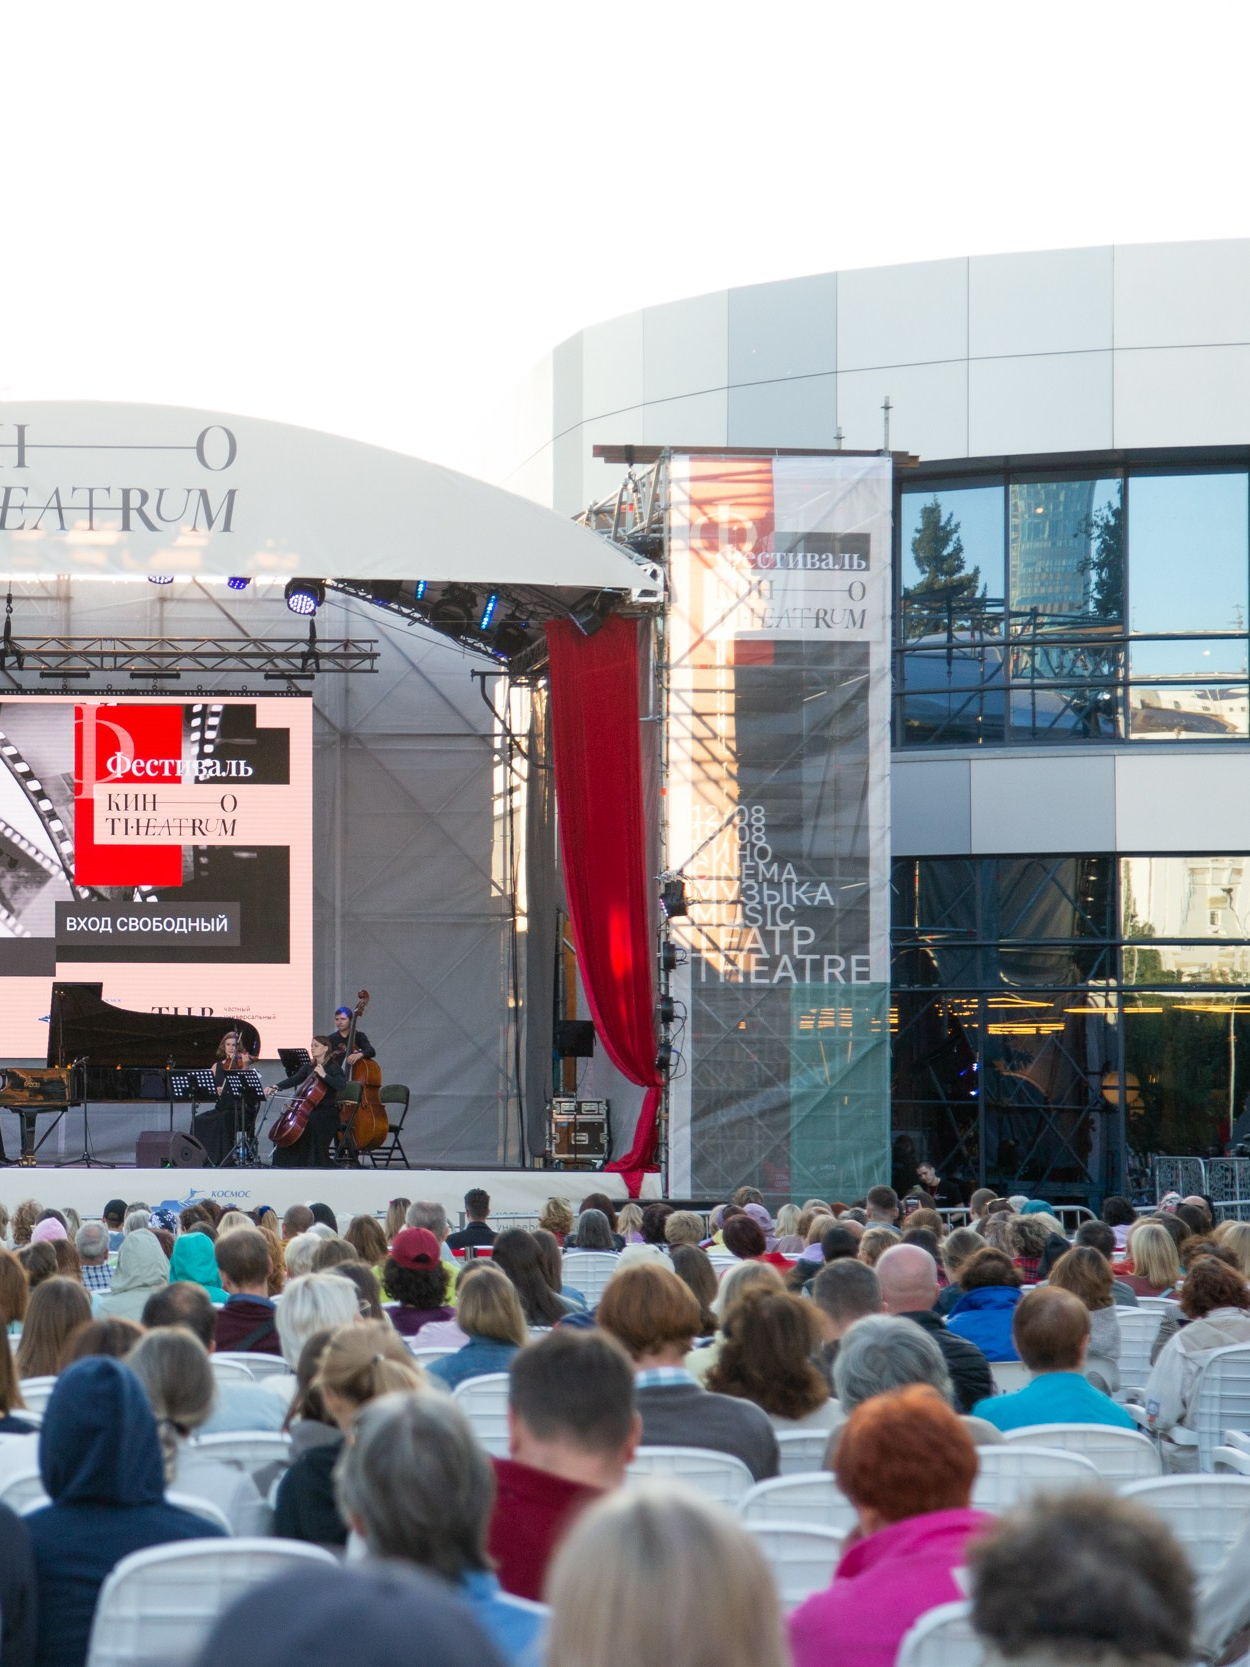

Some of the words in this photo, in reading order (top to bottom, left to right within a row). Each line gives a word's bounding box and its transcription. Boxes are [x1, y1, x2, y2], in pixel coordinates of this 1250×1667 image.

[106, 752, 253, 778] Фестиваль
[66, 916, 112, 933] ВХОД
[116, 914, 228, 934] СВОБОДНЫЙ
[691, 954, 871, 985] THEATRE
